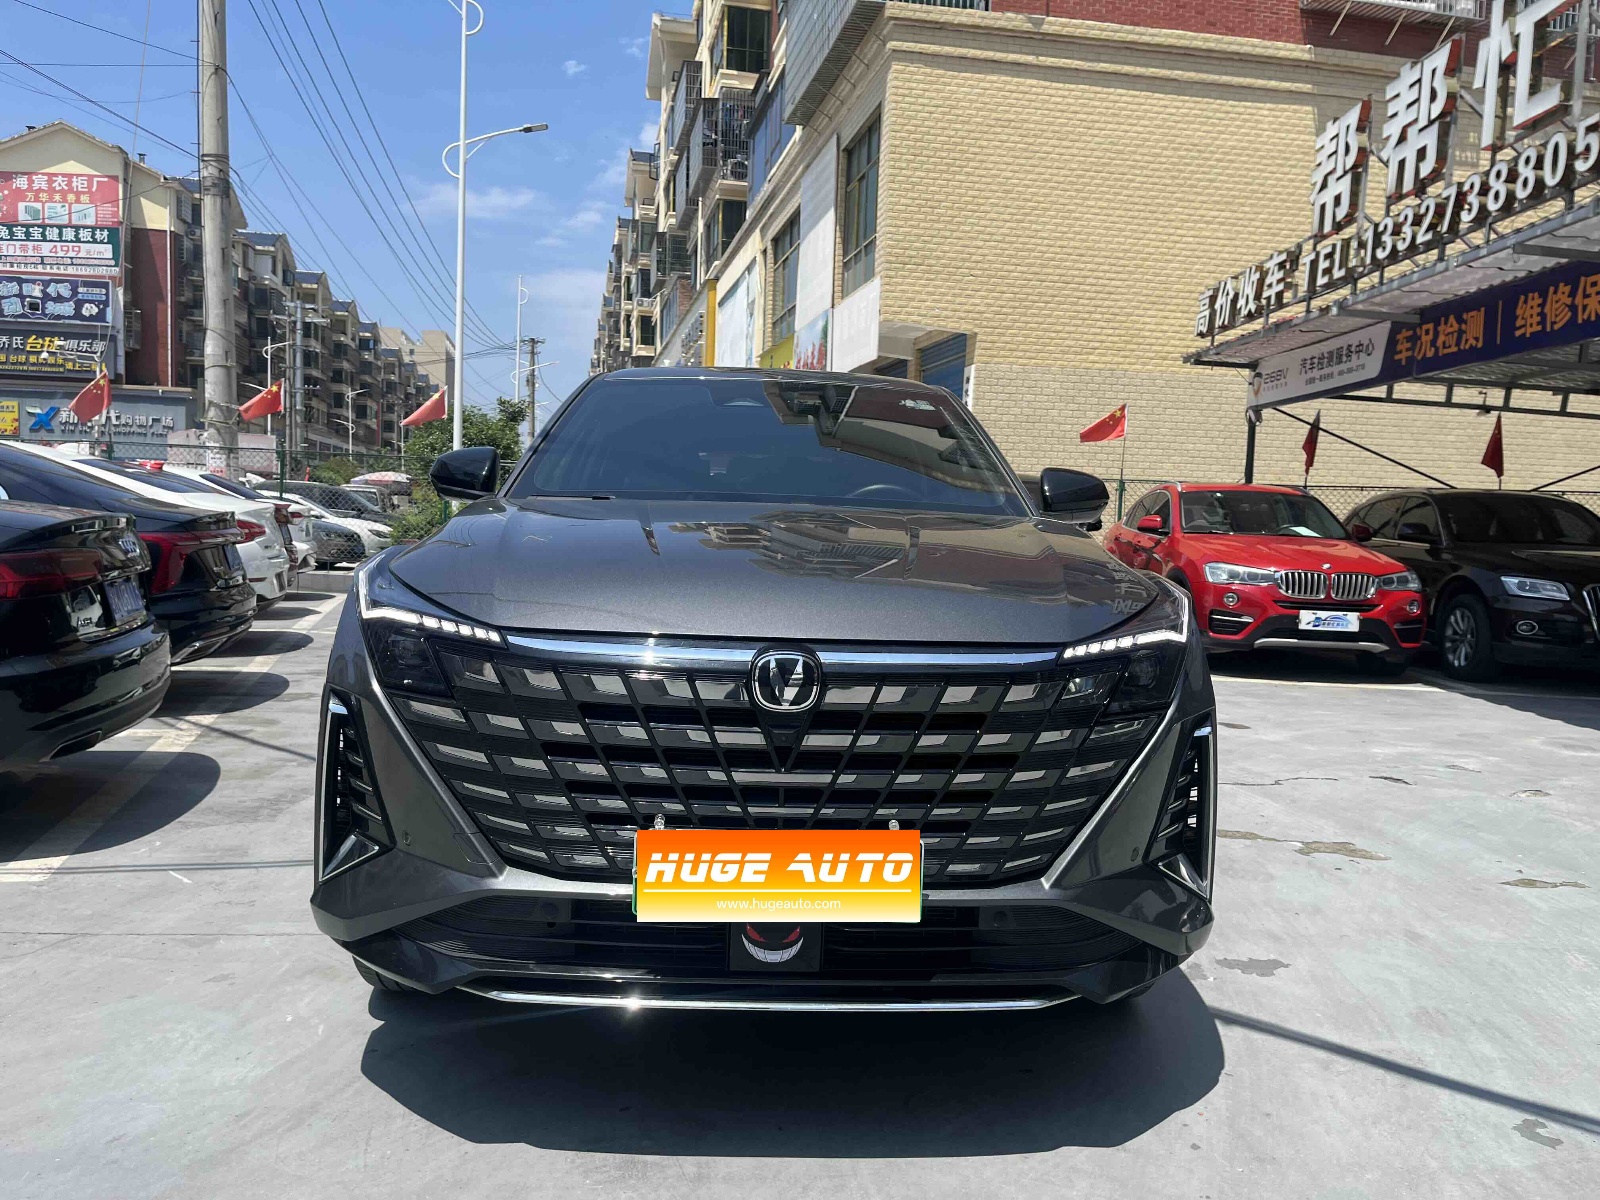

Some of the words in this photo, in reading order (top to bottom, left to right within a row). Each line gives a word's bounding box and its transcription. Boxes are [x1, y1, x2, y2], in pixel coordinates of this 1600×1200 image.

[1309, 0, 1577, 235] 帮帮忙
[12, 174, 109, 192] 海宾衣柜厂
[49, 244, 82, 256] 499
[1194, 252, 1287, 336] 高价收车
[1394, 307, 1485, 366] 车况检测
[1299, 338, 1375, 376] 汽车检测服务中心
[59, 407, 174, 428] 新代购物广场
